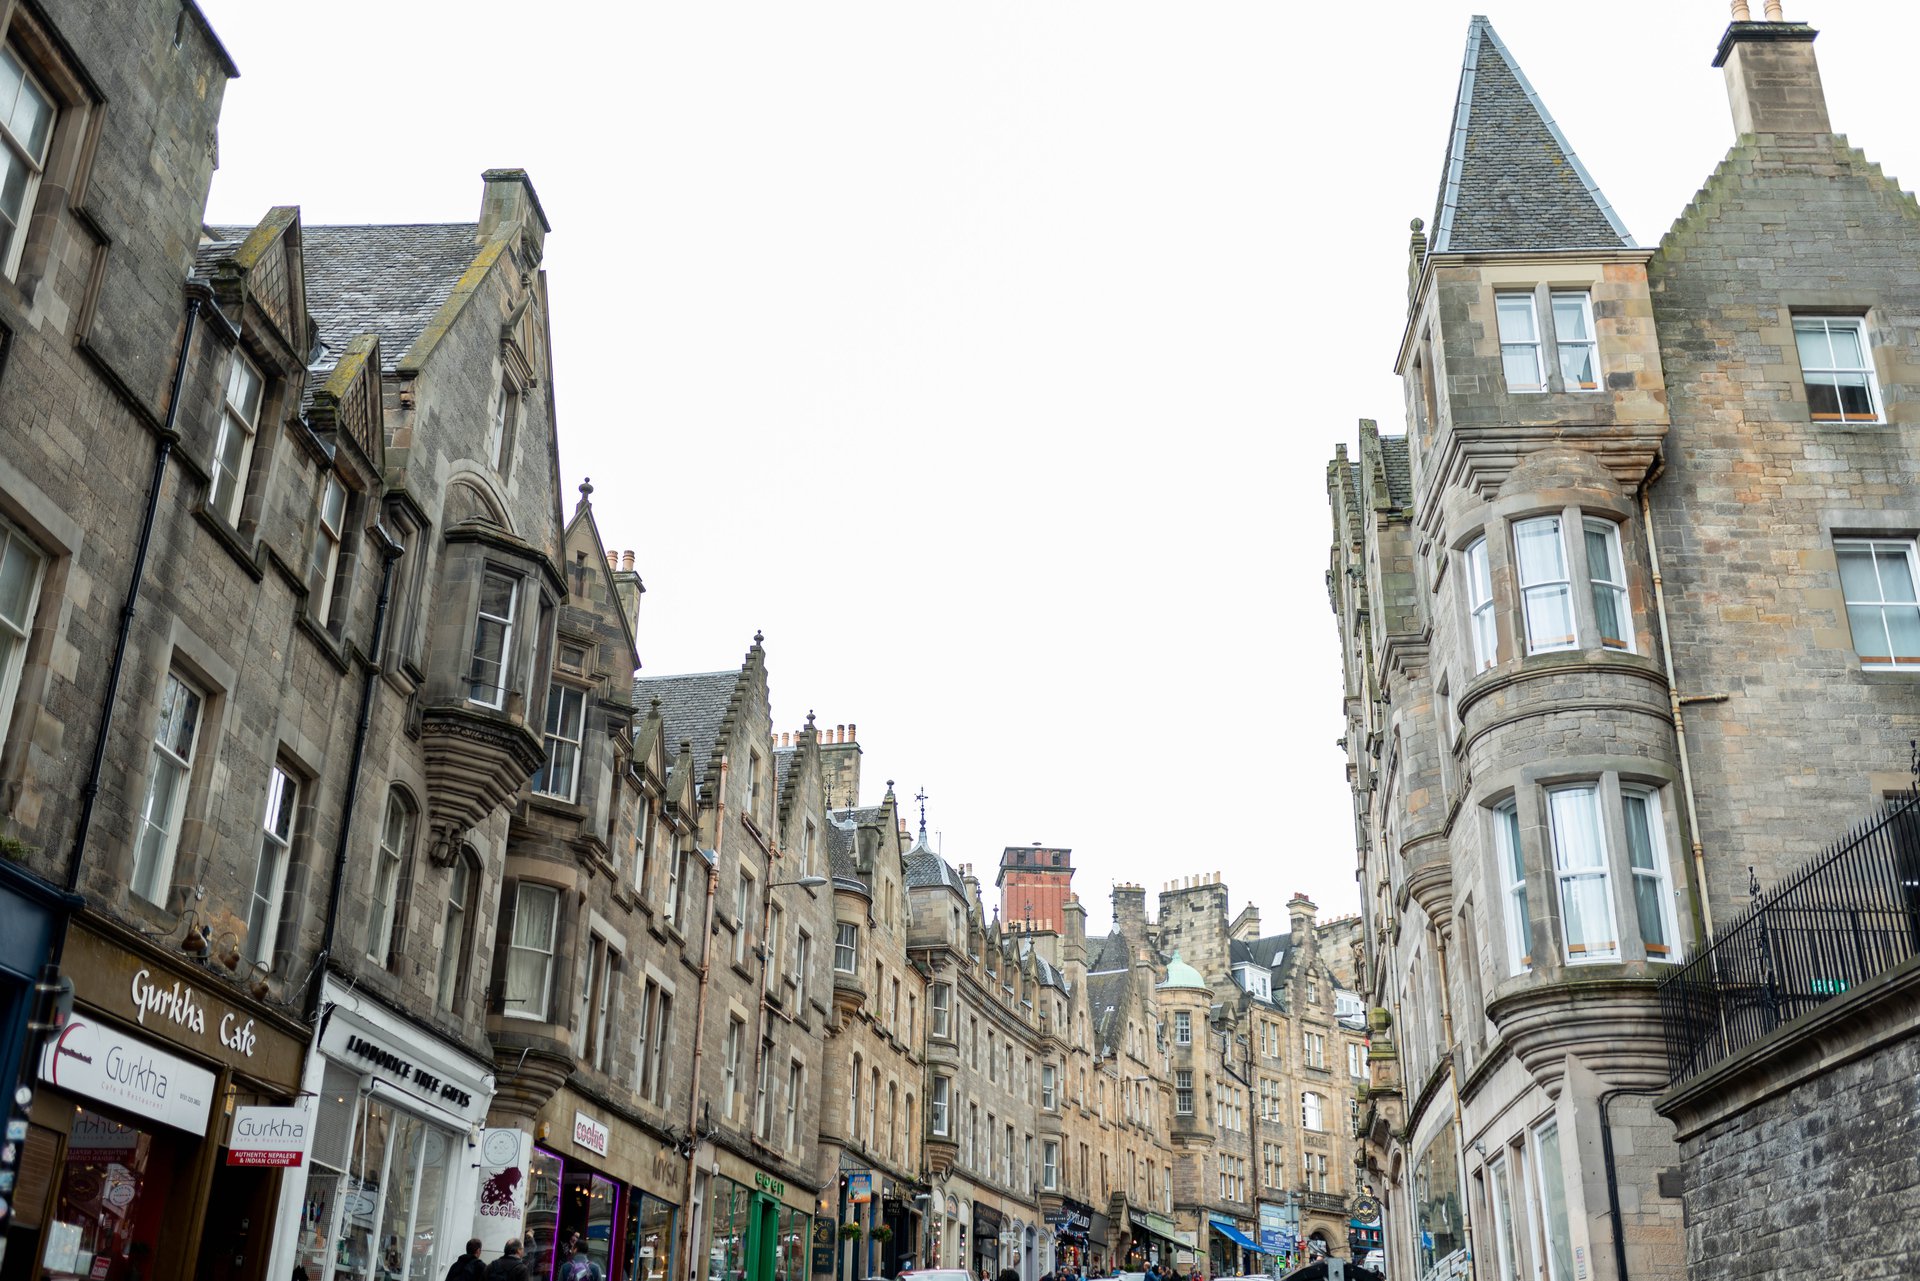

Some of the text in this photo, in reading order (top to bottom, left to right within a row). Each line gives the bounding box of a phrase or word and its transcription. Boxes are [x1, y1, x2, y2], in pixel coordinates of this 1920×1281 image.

[132, 969, 256, 1057] Gurkha Cafe
[101, 1081, 116, 1093] Cafe
[106, 1046, 167, 1099] Gurkha
[346, 1034, 472, 1108] LIQUORICE TREE GIFTS
[237, 1117, 304, 1138] Gurkha
[234, 1151, 267, 1159] AUTHENTIC
[652, 1155, 679, 1190] MYSA
